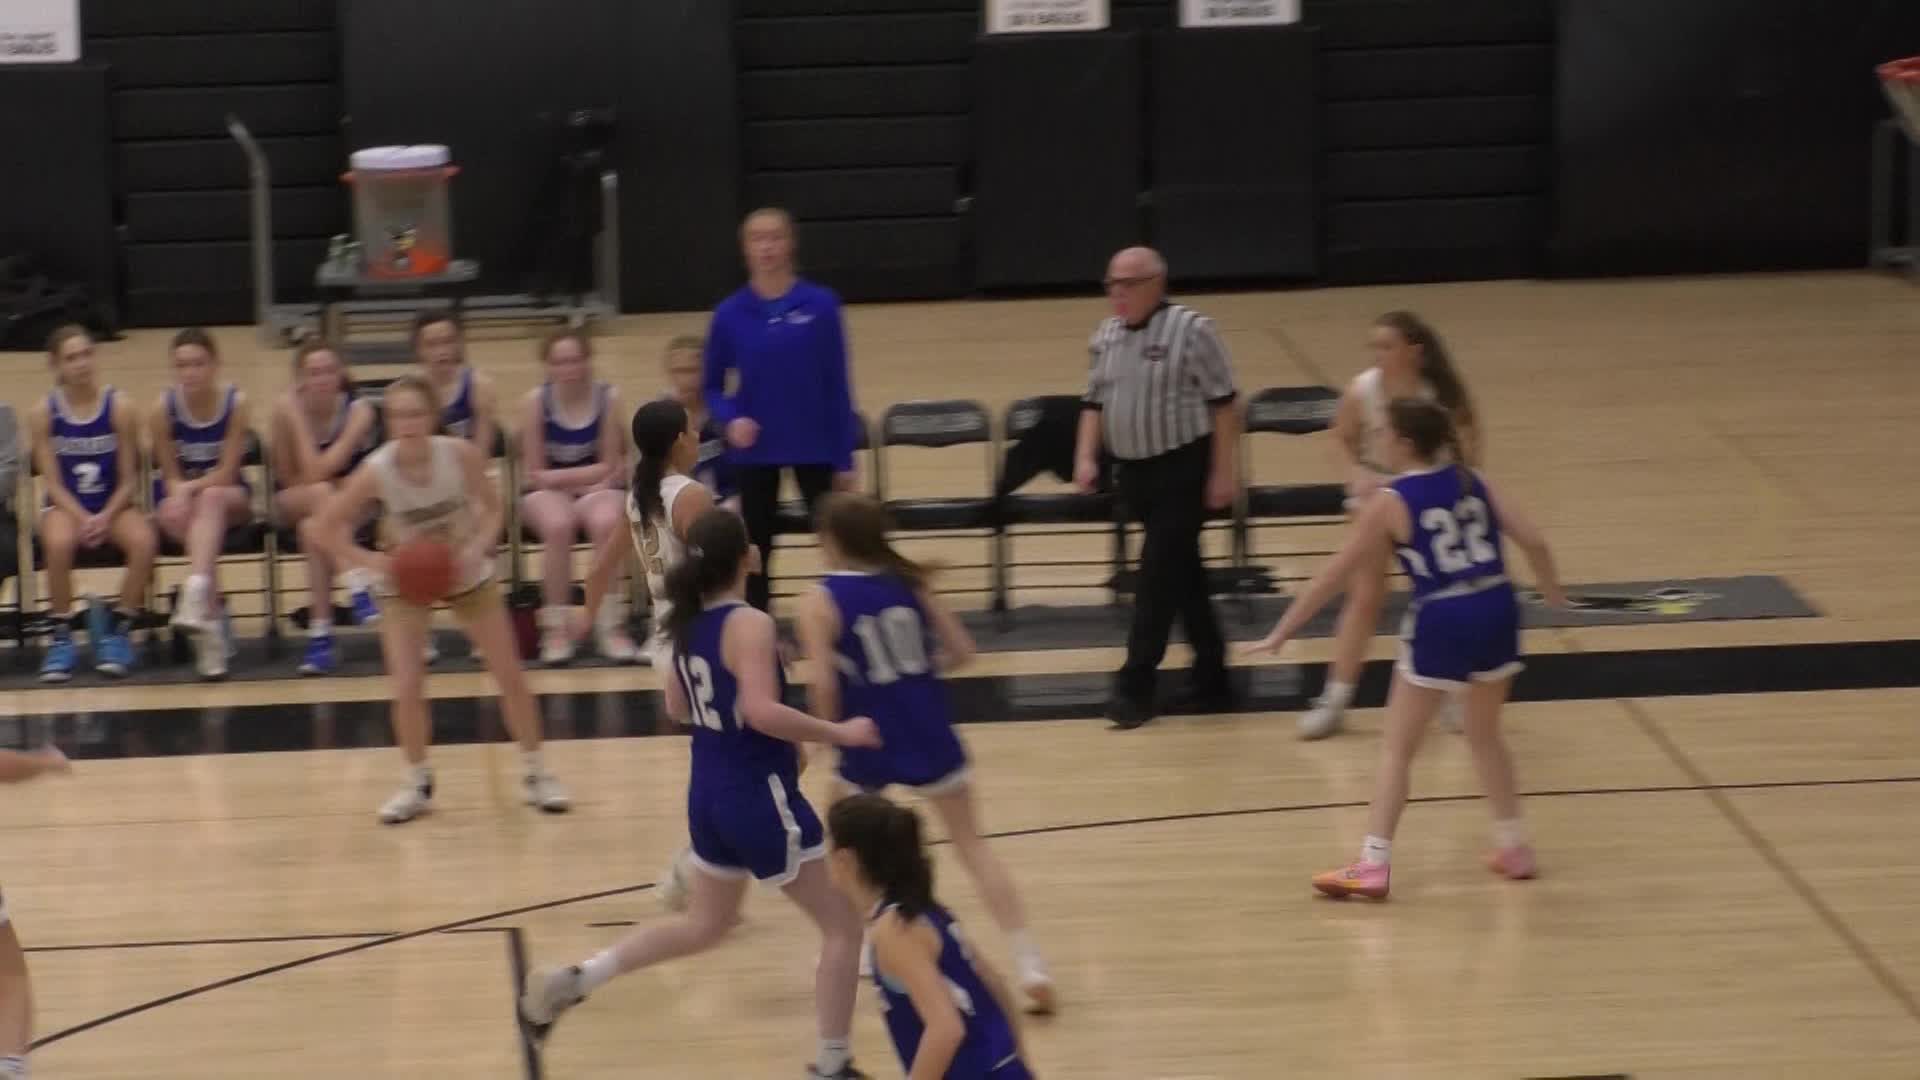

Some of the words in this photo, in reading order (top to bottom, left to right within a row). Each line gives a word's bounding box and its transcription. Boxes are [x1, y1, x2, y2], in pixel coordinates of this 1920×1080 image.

[72, 463, 105, 494] 2
[1420, 497, 1497, 573] 22
[853, 606, 928, 684] 10
[677, 654, 723, 732] 12
